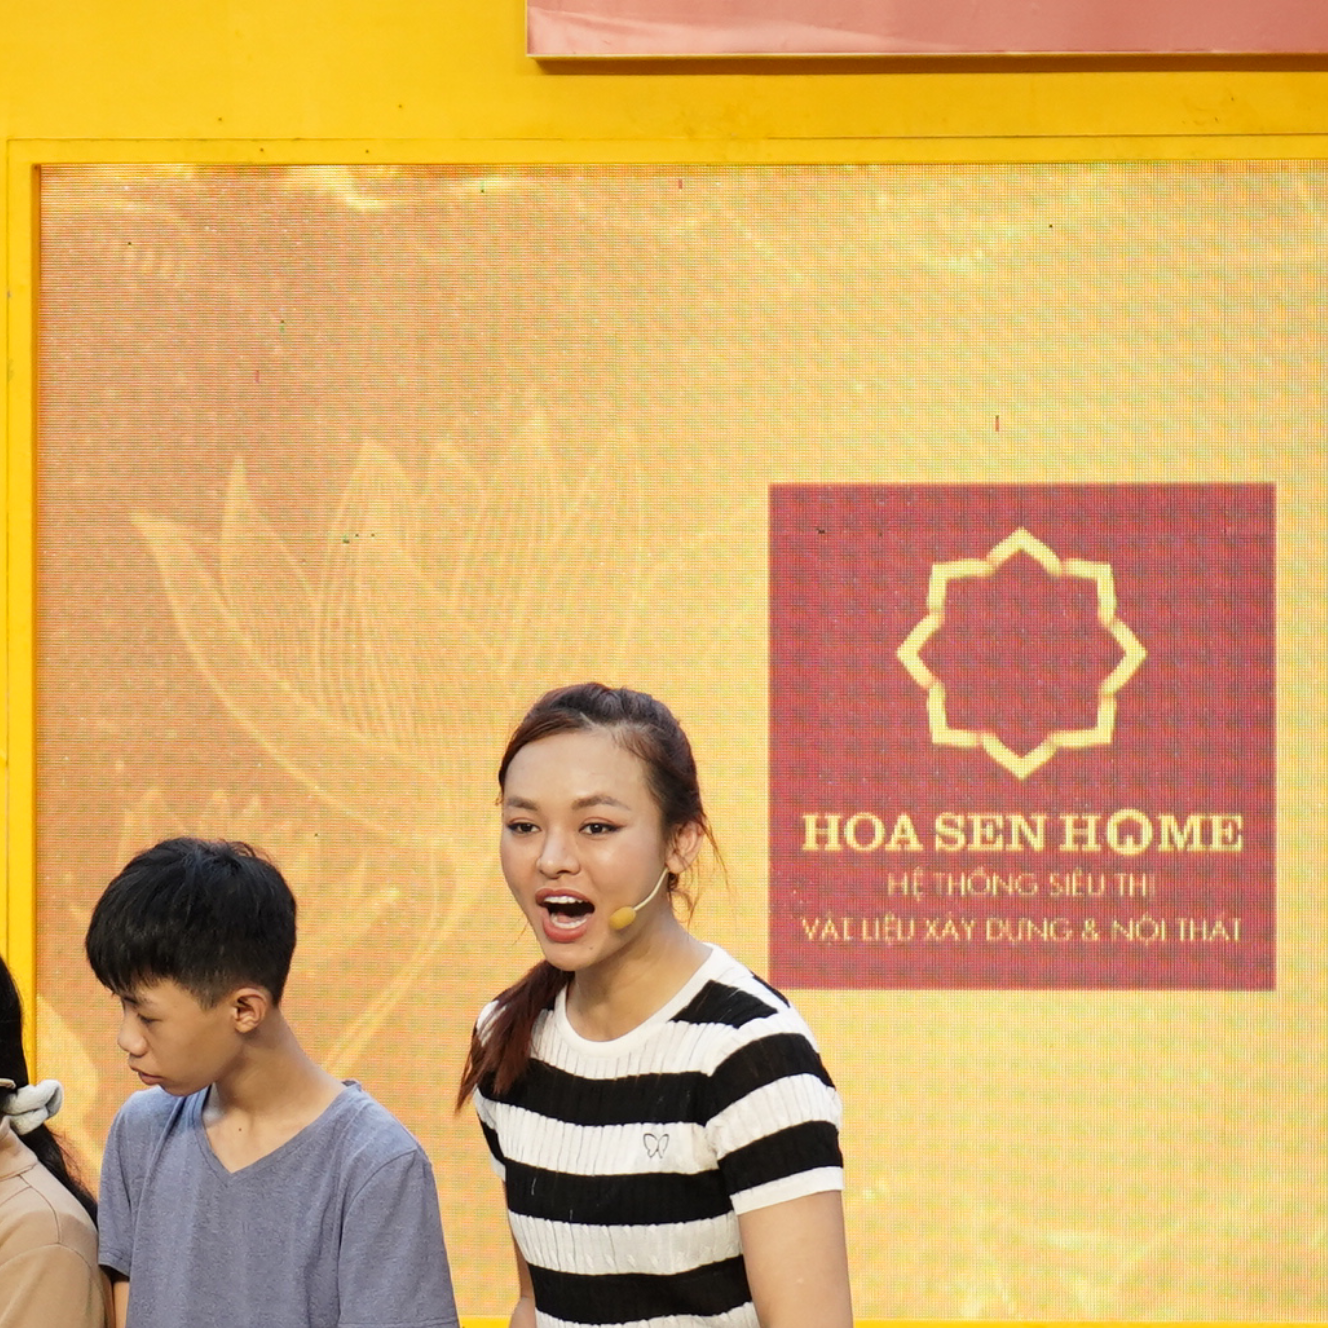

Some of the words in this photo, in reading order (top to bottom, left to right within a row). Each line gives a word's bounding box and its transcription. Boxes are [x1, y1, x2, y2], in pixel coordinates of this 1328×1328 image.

[801, 812, 924, 852] HOA
[934, 812, 1047, 852] SEN
[1059, 808, 1243, 856] HOME
[887, 866, 924, 902] HỆ
[1049, 866, 1106, 897] SIÊU
[861, 911, 916, 946] LIỆU
[924, 911, 977, 941] XÂY
[1082, 918, 1100, 942] &
[1112, 911, 1167, 946] NỘI
